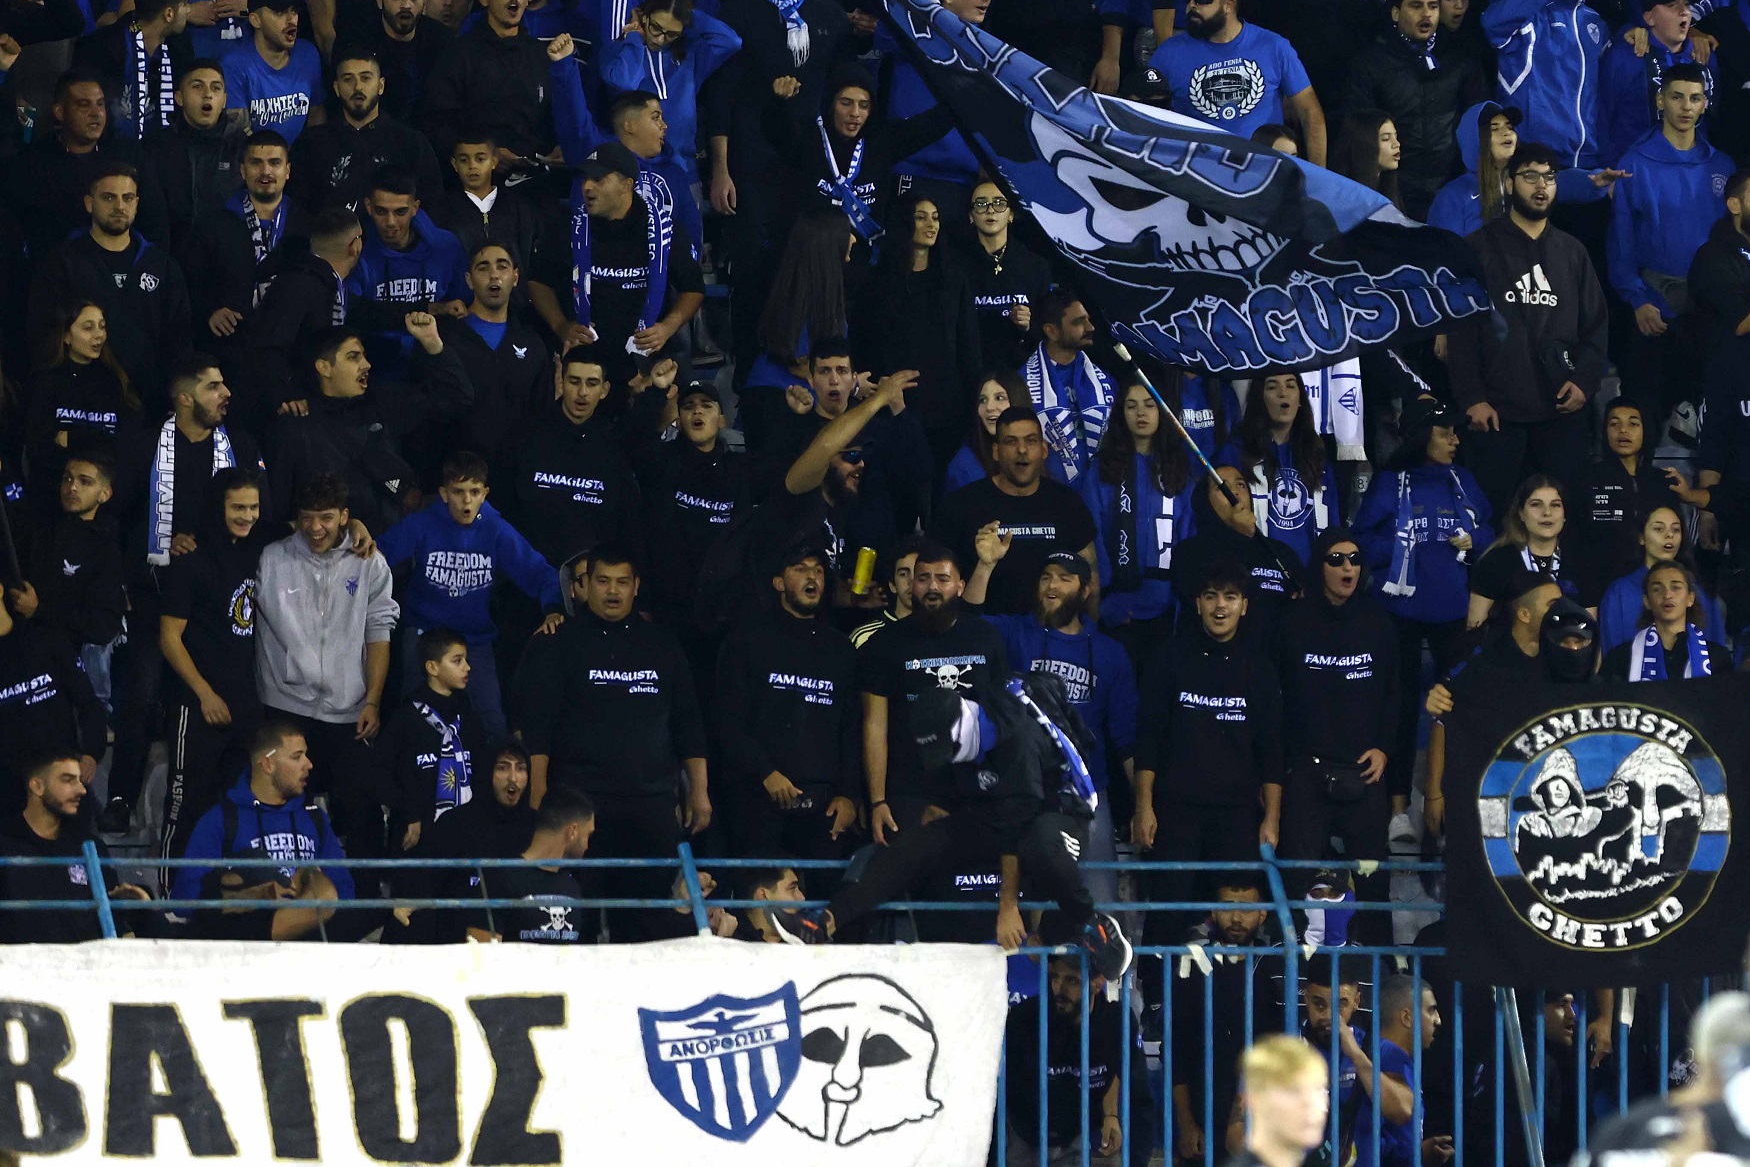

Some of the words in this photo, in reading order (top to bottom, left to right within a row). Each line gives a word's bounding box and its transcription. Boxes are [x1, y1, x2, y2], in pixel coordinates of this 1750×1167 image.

[1504, 288, 1559, 308] adidas
[424, 551, 493, 571] FREEDOM
[424, 566, 494, 587] FAMAGUSTA
[587, 670, 660, 683] FAMAGUSTA
[1345, 669, 1374, 682] Ghetto
[628, 683, 660, 695] Ghetto
[1178, 691, 1248, 709] FAMAGUSTA
[1513, 706, 1695, 760] FAMAGUSTA
[1527, 895, 1685, 948] GHETTO
[667, 1026, 777, 1062] ΑΝΟΡΘΩΣΙΣ
